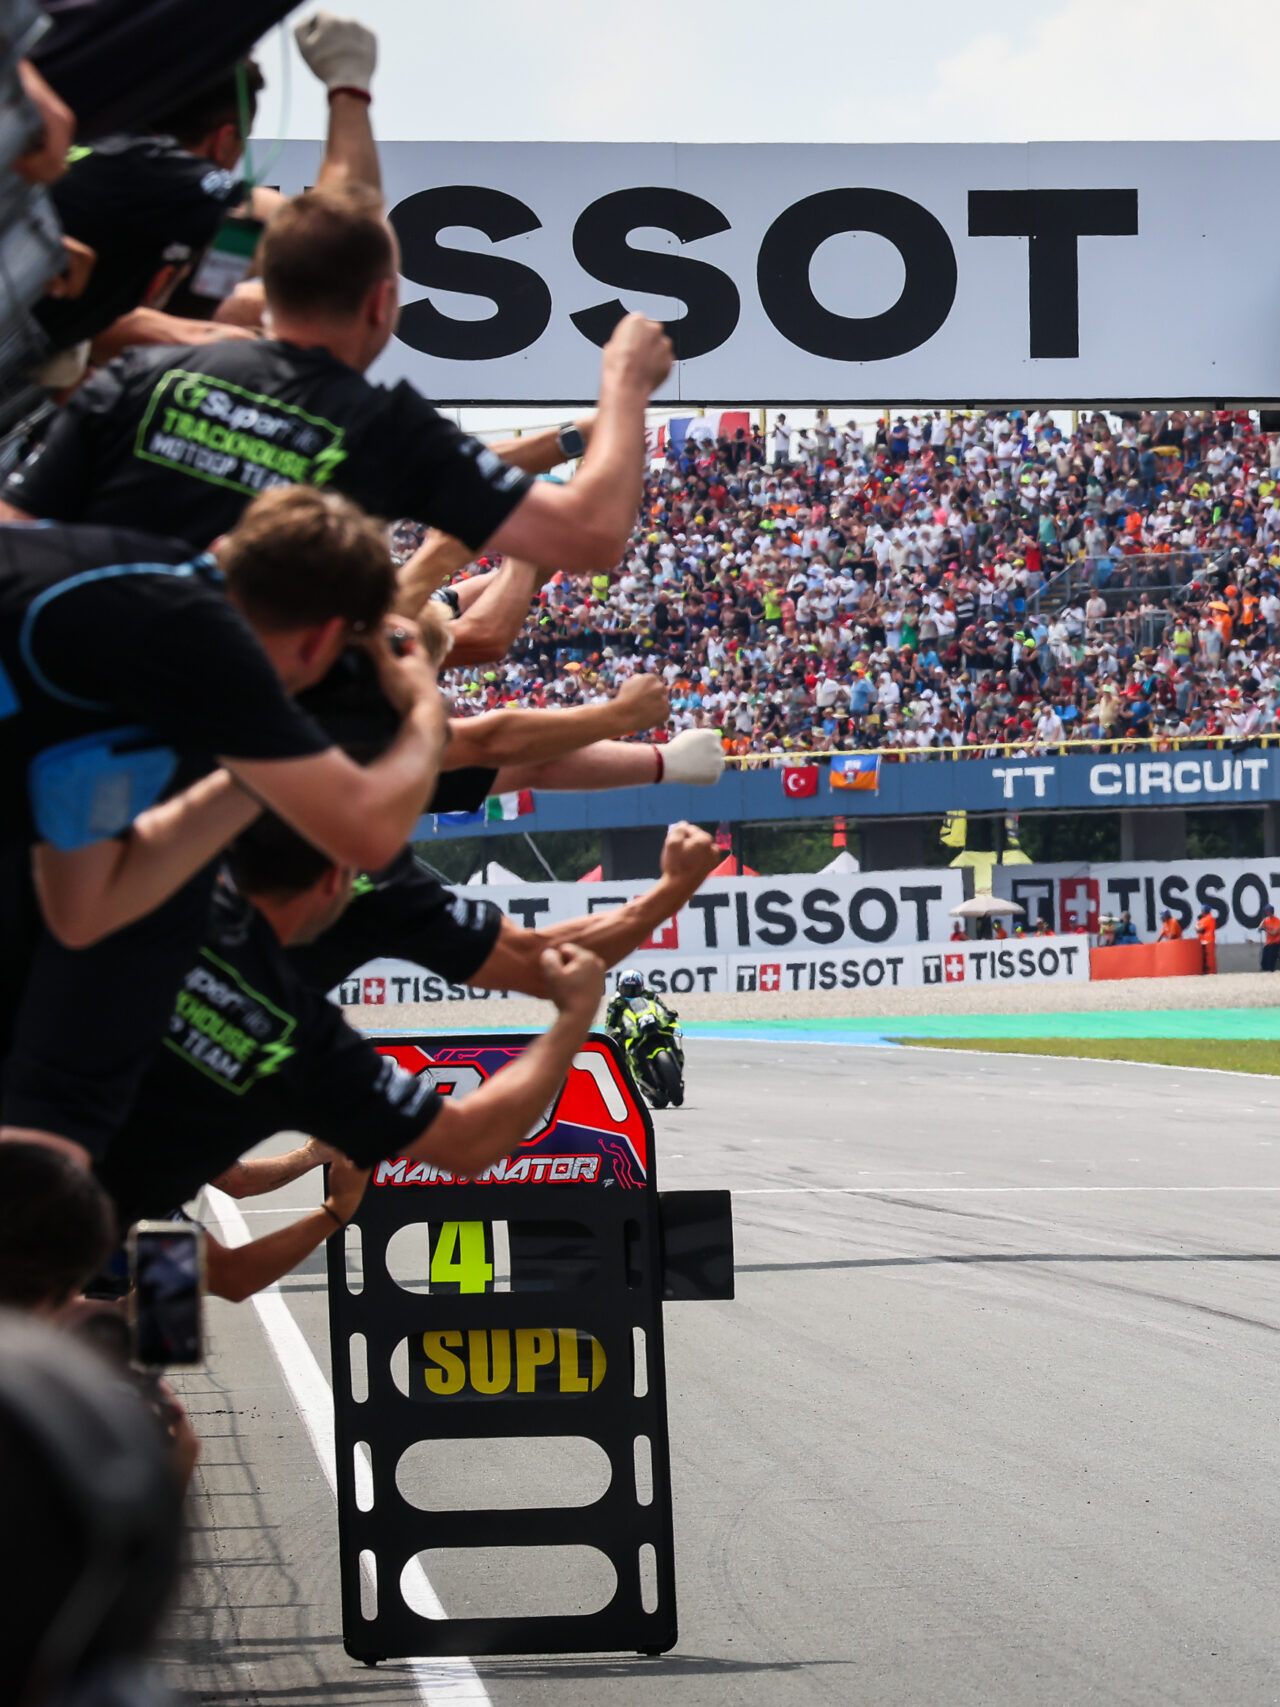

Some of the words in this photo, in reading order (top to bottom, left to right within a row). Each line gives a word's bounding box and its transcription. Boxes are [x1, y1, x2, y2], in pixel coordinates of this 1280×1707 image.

[254, 185, 1138, 361] SSOT
[992, 766, 1055, 798] TT
[1089, 758, 1269, 795] CIRCUIT
[688, 885, 943, 949] TISSOT
[786, 957, 904, 991] TISSOT
[969, 945, 1079, 981] TISSOT
[431, 1221, 493, 1294] 4
